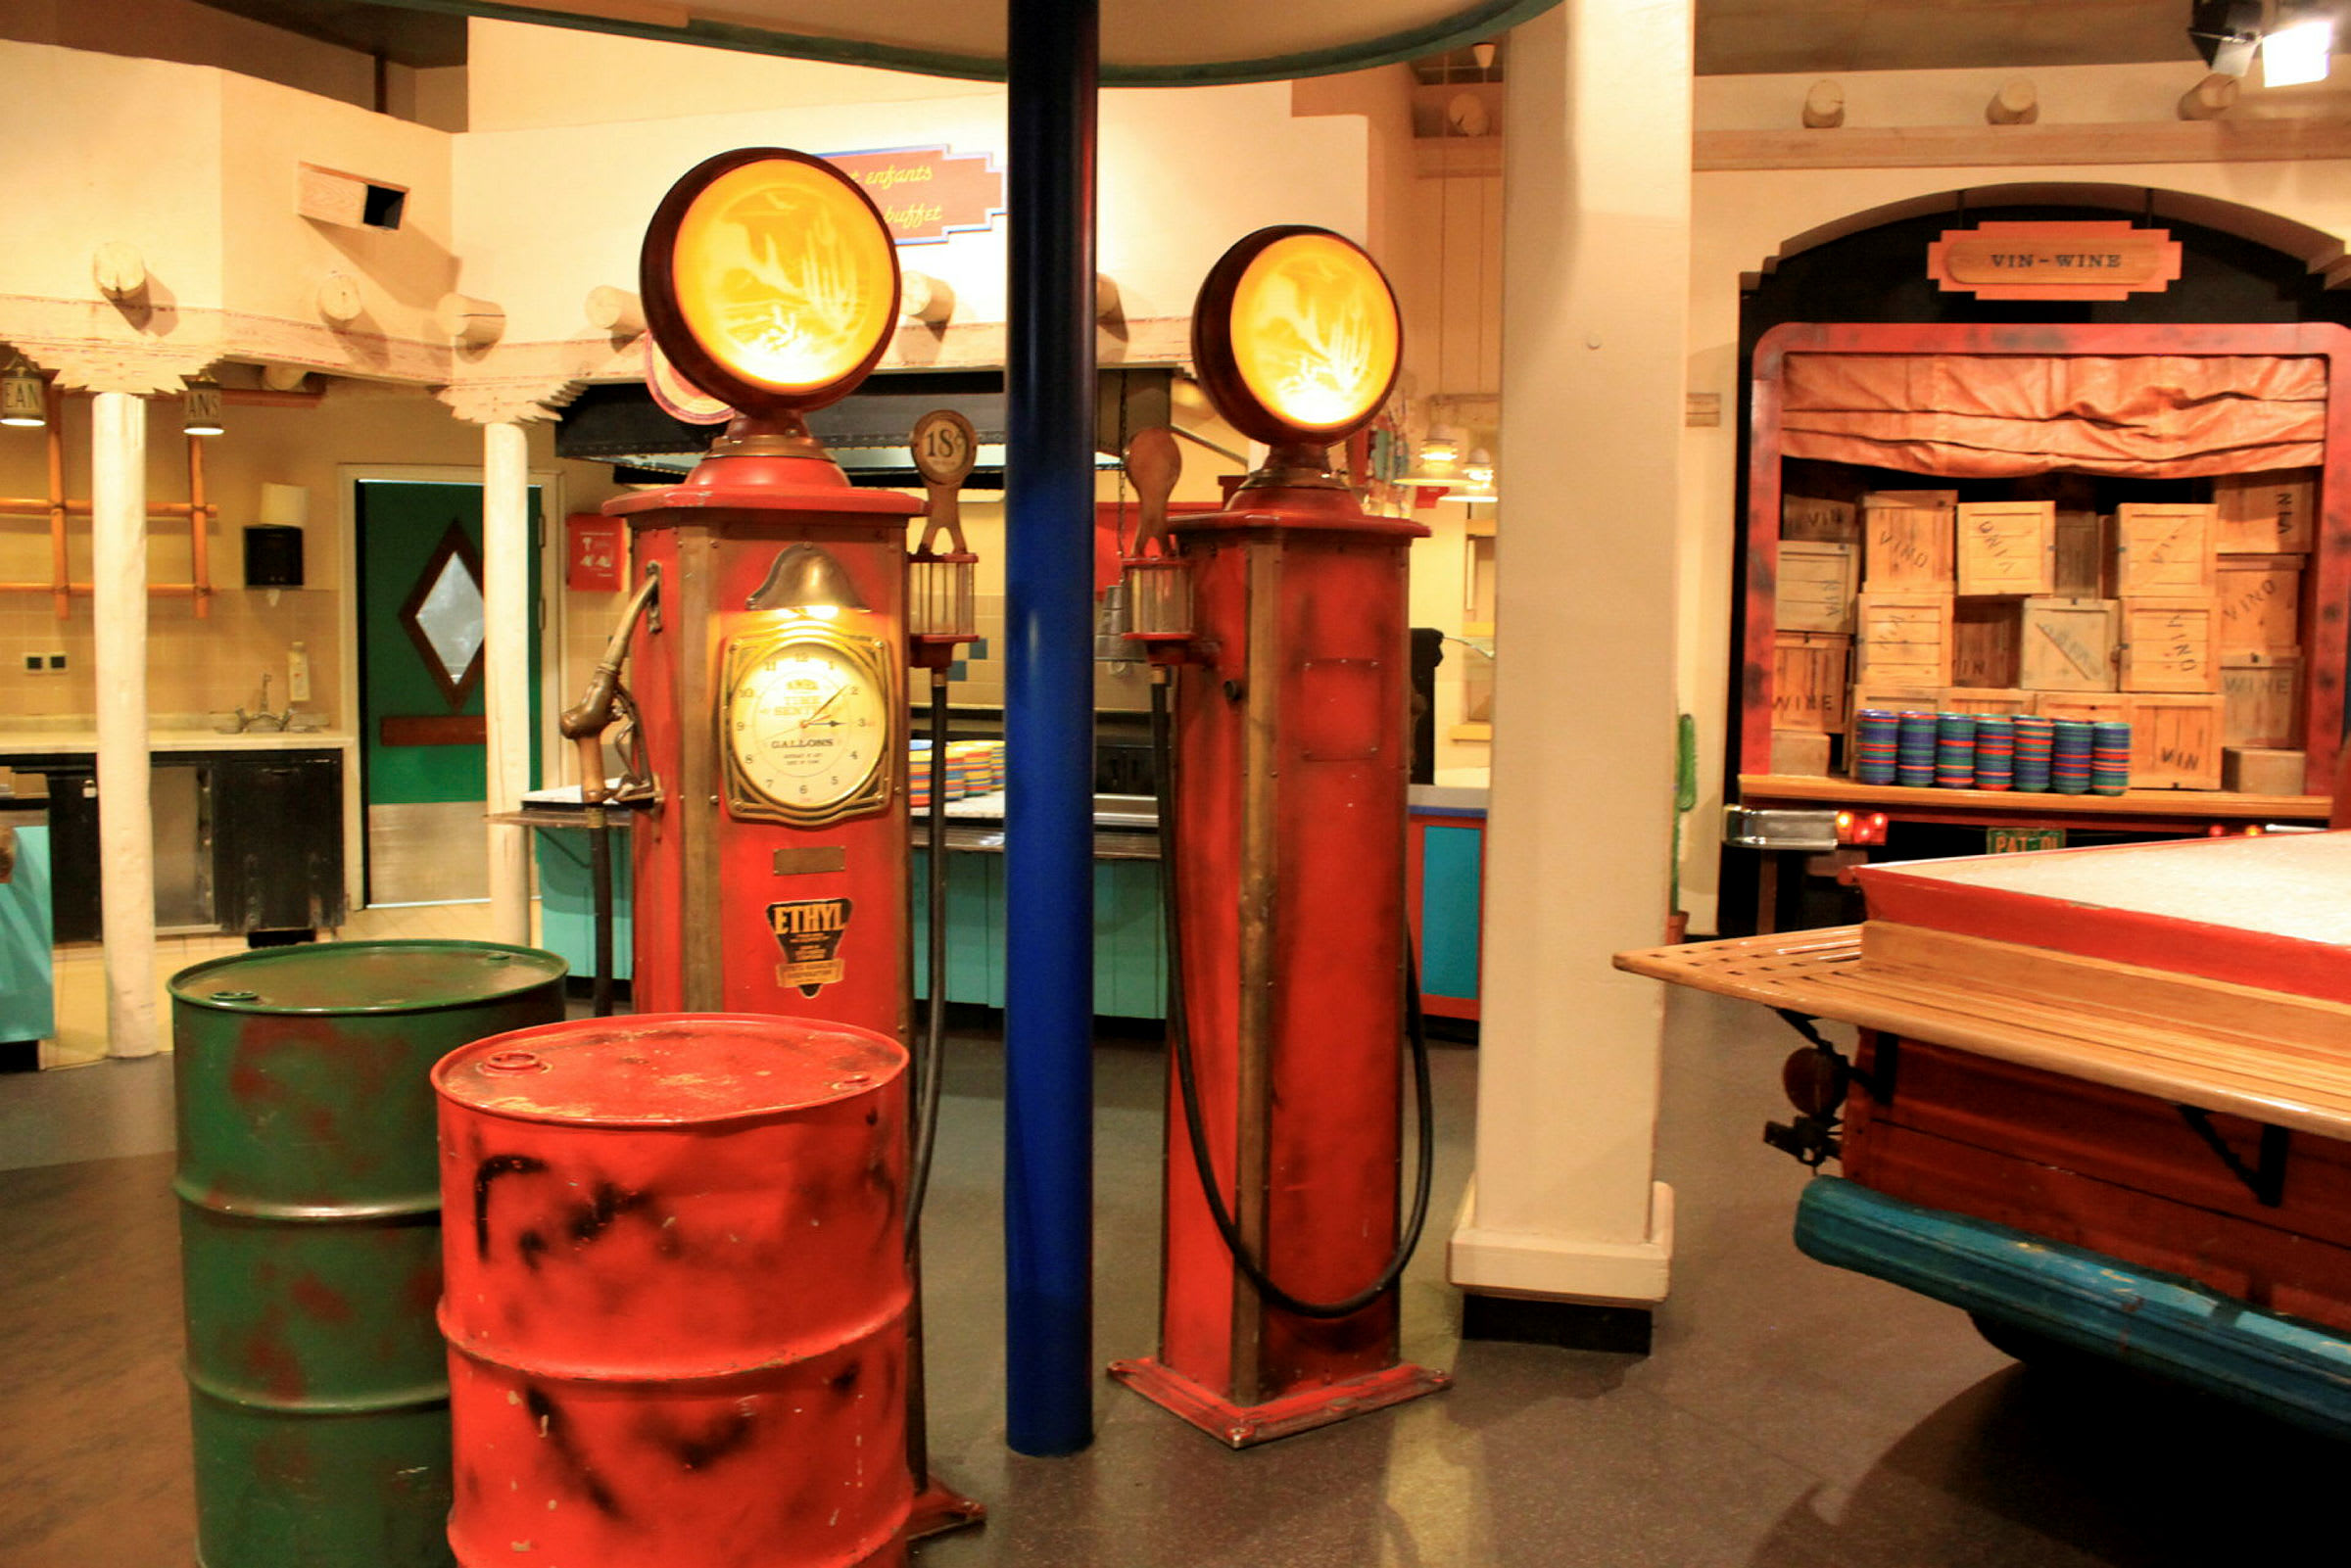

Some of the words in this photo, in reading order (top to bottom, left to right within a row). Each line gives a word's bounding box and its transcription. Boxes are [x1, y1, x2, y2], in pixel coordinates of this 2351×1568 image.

[864, 165, 933, 190] enfants
[884, 204, 940, 229] buffet
[771, 738, 834, 748] GALLONS
[744, 755, 753, 764] 8
[850, 750, 858, 760] 4
[2161, 747, 2199, 771] VIN
[766, 780, 773, 788] 7
[831, 776, 839, 784] 5
[799, 785, 807, 794] 6
[774, 902, 845, 934] ETHYL
